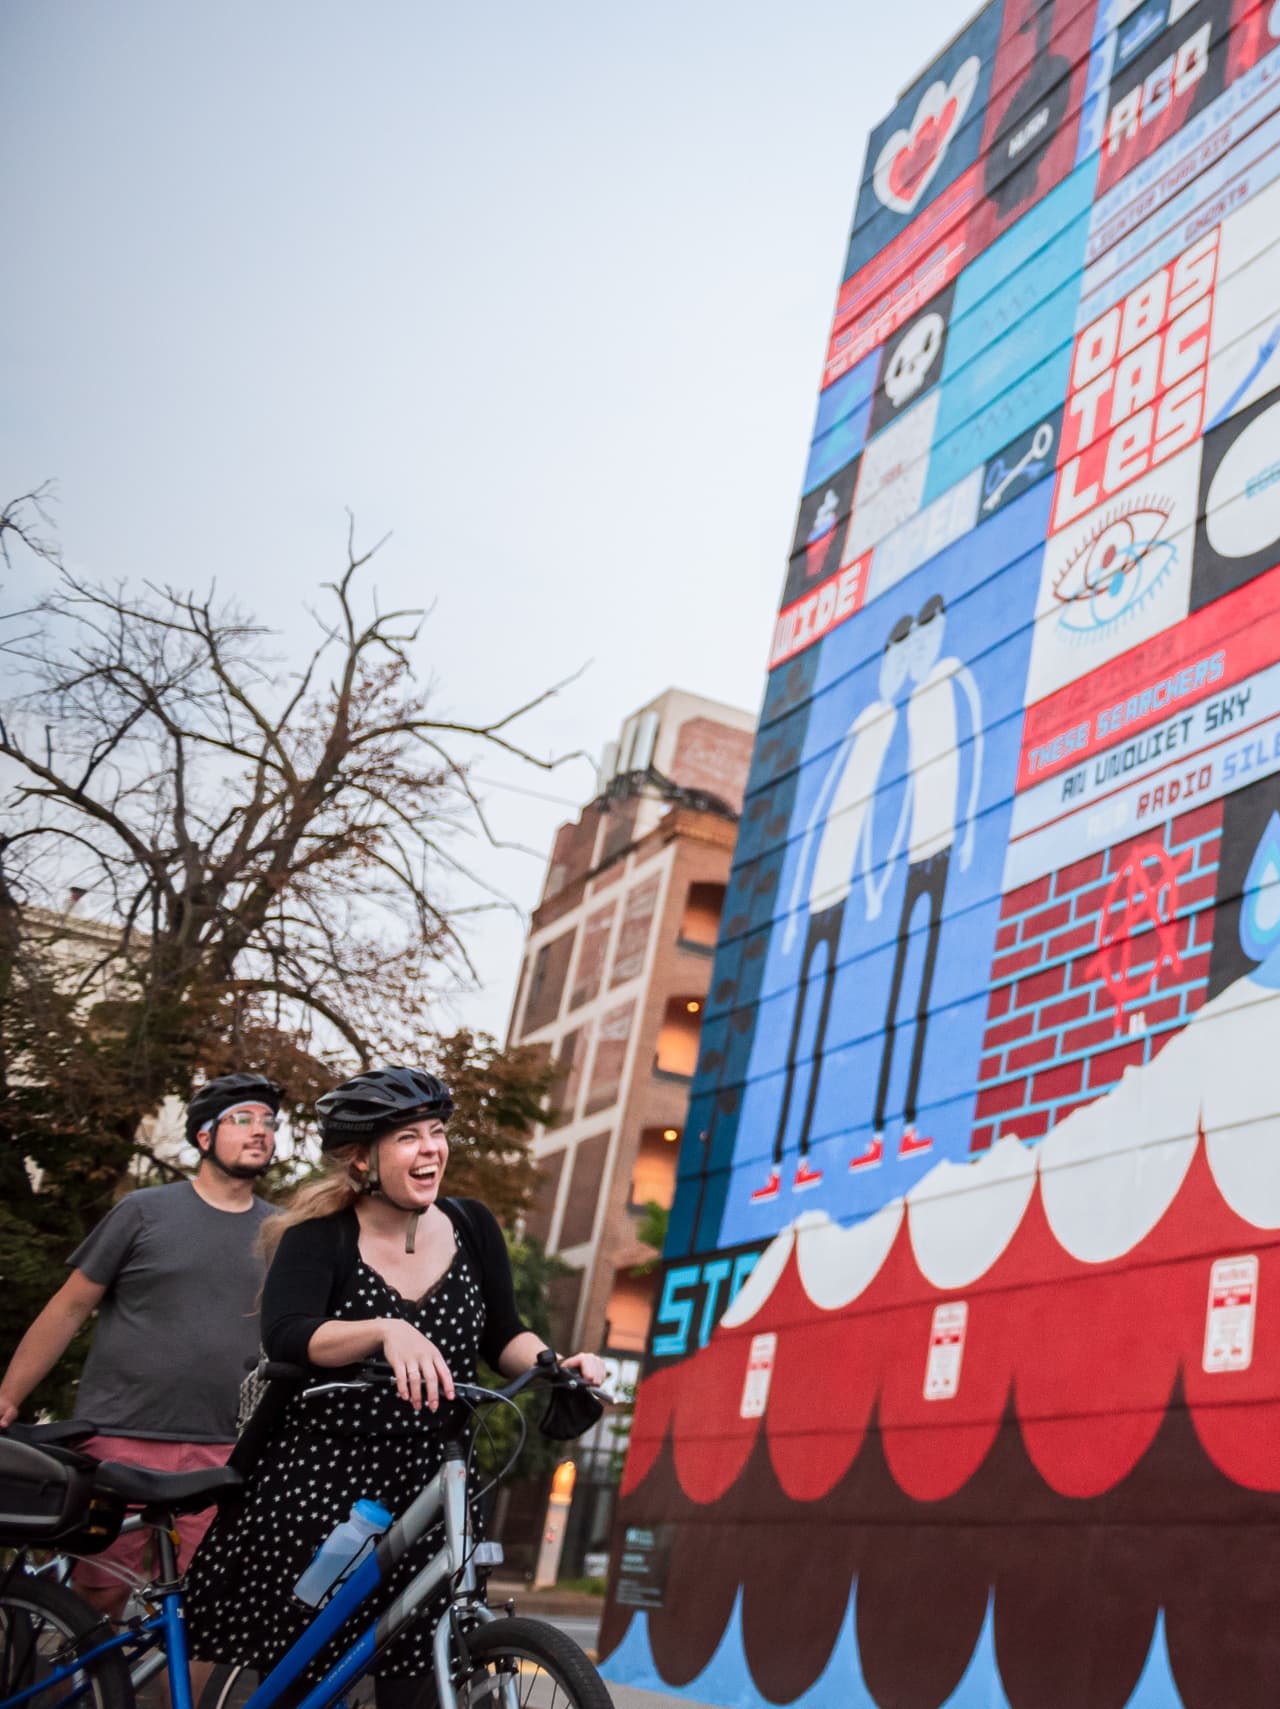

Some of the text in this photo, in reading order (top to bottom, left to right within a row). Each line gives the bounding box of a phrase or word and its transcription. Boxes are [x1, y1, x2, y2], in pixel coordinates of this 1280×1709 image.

[1069, 294, 1209, 450] TAC
[1073, 228, 1219, 389] OBS
[1027, 720, 1092, 775] THESE
[1096, 648, 1226, 740] SEARCHERS
[1061, 687, 1252, 803] AN UNQUIET SKY
[1136, 764, 1213, 819] RADIO
